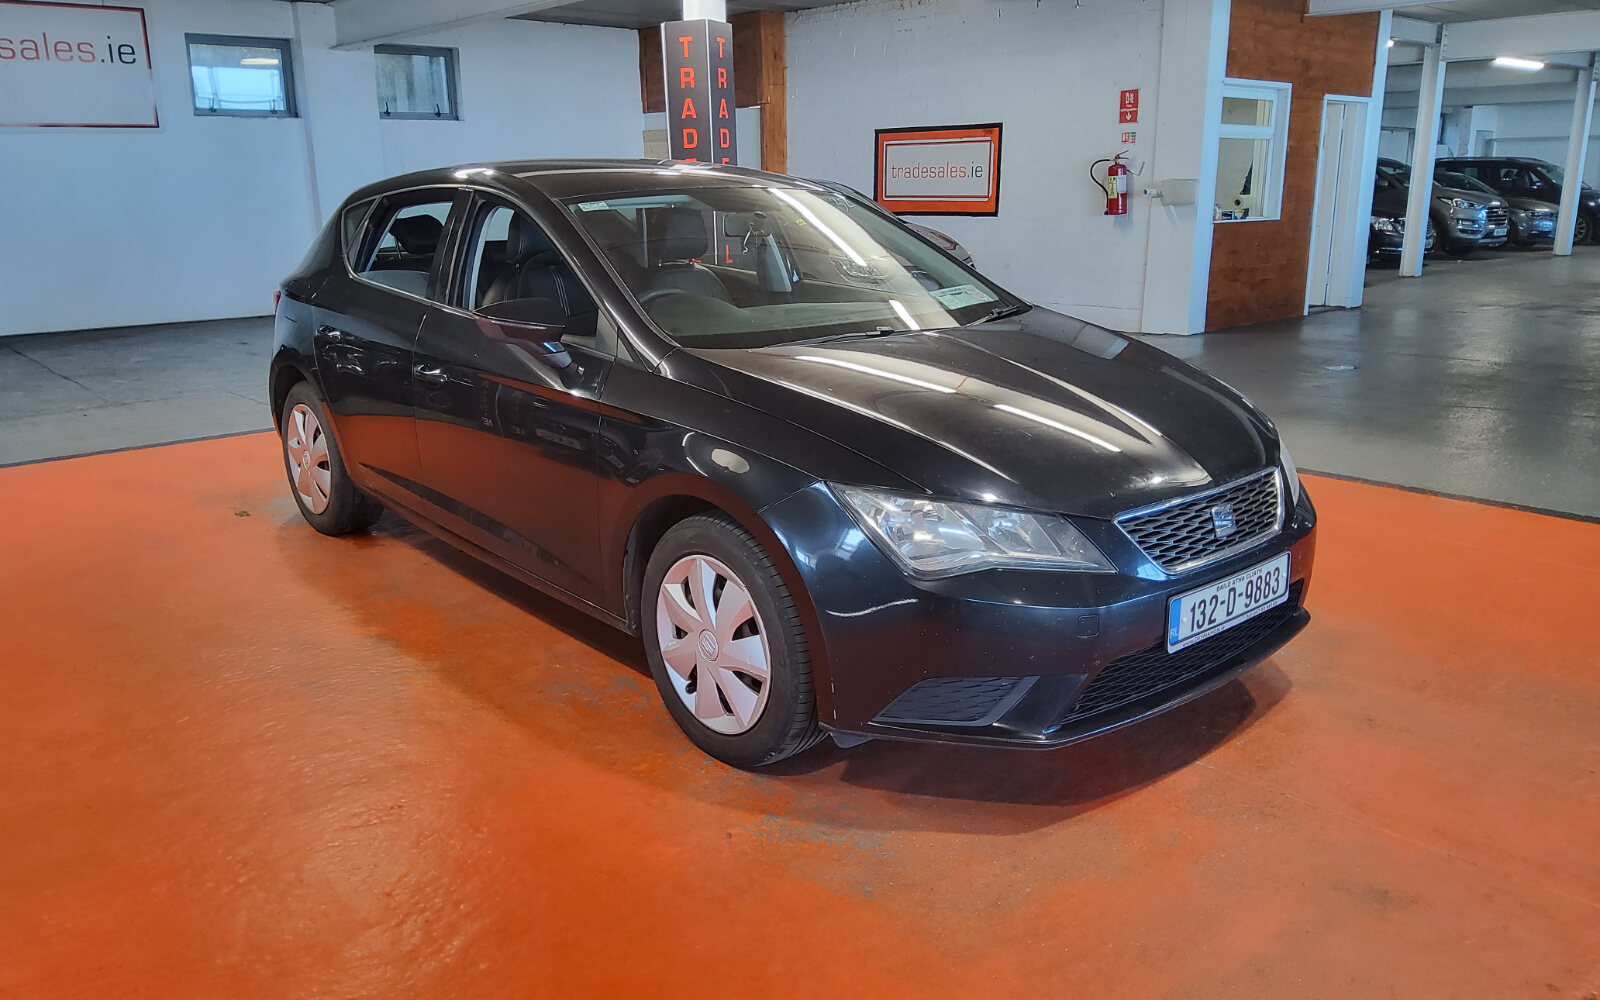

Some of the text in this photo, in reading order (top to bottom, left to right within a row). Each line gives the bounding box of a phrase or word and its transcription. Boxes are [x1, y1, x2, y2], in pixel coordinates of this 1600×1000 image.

[679, 36, 699, 162] TRAD
[891, 161, 983, 179] tradesales.ie
[1190, 567, 1280, 633] 132-D-9883
